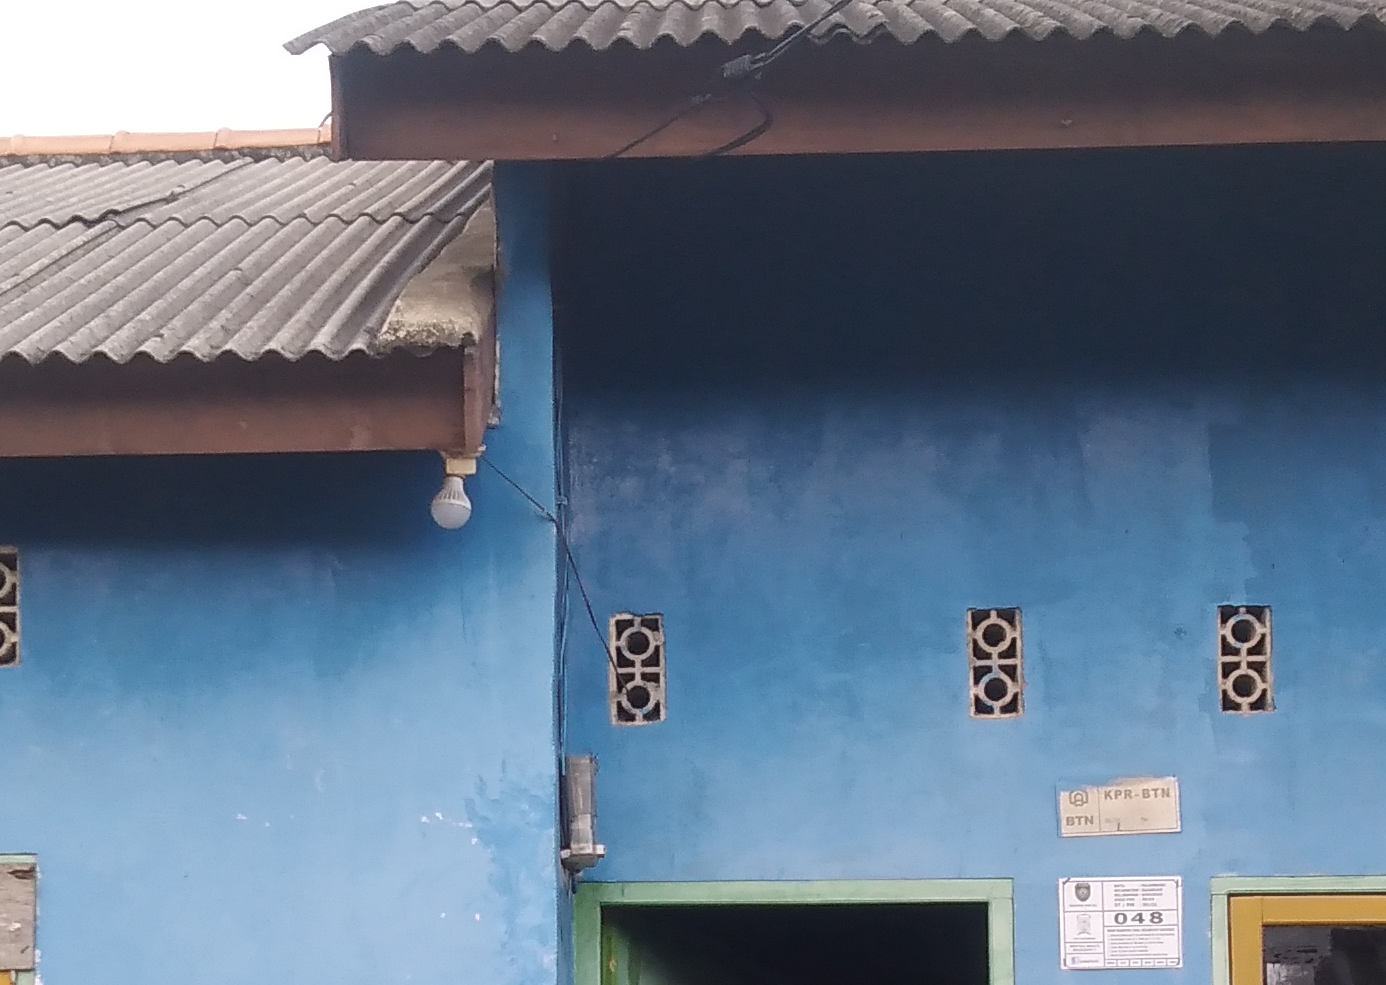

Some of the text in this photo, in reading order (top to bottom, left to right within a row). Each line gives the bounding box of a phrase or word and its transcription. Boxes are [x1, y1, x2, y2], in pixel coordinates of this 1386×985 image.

[1104, 787, 1171, 801] KPR-BTN
[1066, 815, 1094, 826] BTN
[1114, 911, 1164, 925] 048
